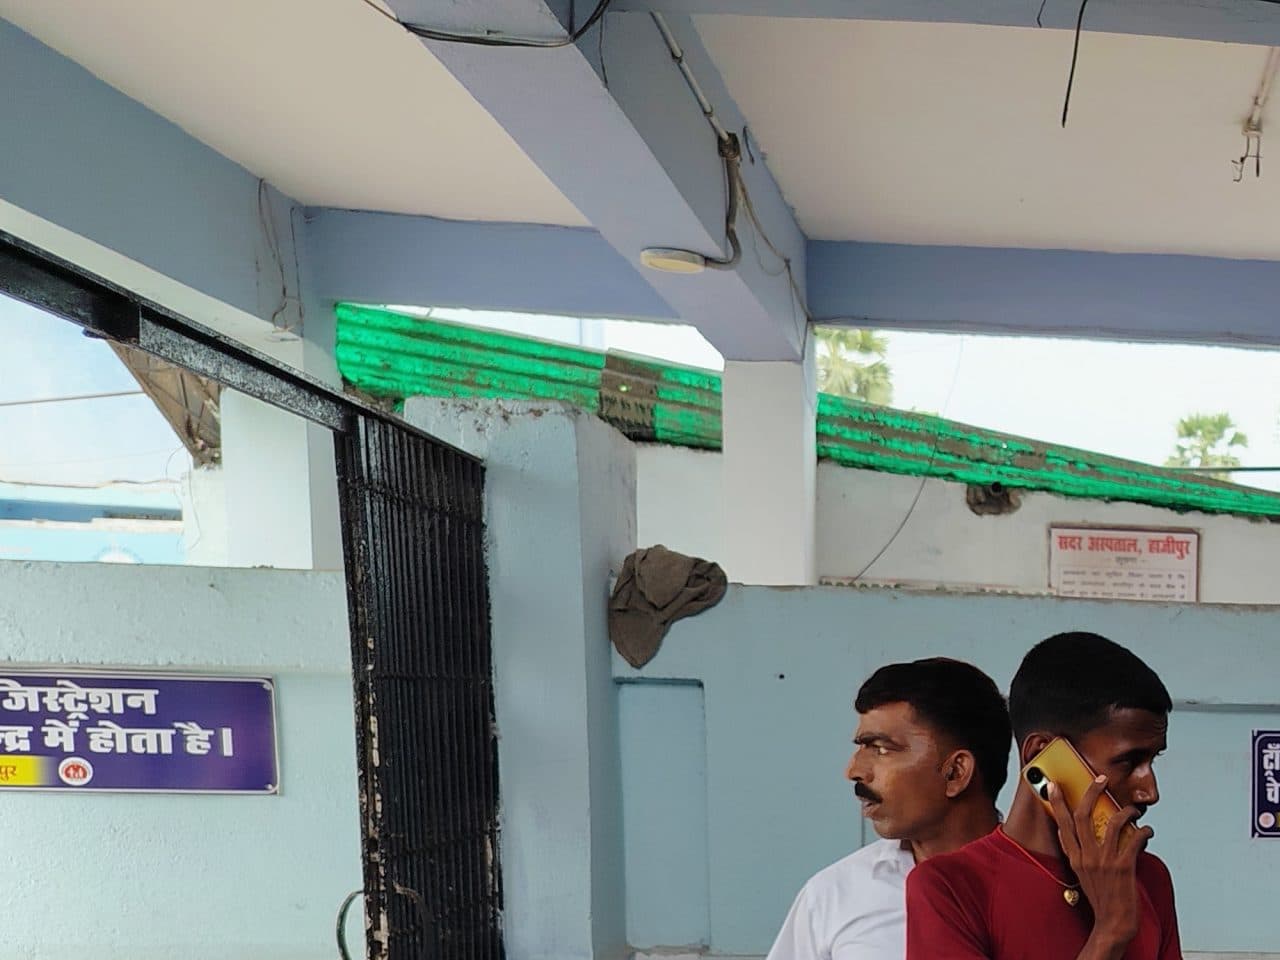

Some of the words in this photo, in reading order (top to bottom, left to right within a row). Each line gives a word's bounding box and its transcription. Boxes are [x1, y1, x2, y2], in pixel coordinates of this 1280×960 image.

[1057, 536, 1082, 550] सदर
[1148, 536, 1191, 559] हाजीपुर
[41, 719, 80, 753] में
[86, 720, 177, 755] होता
